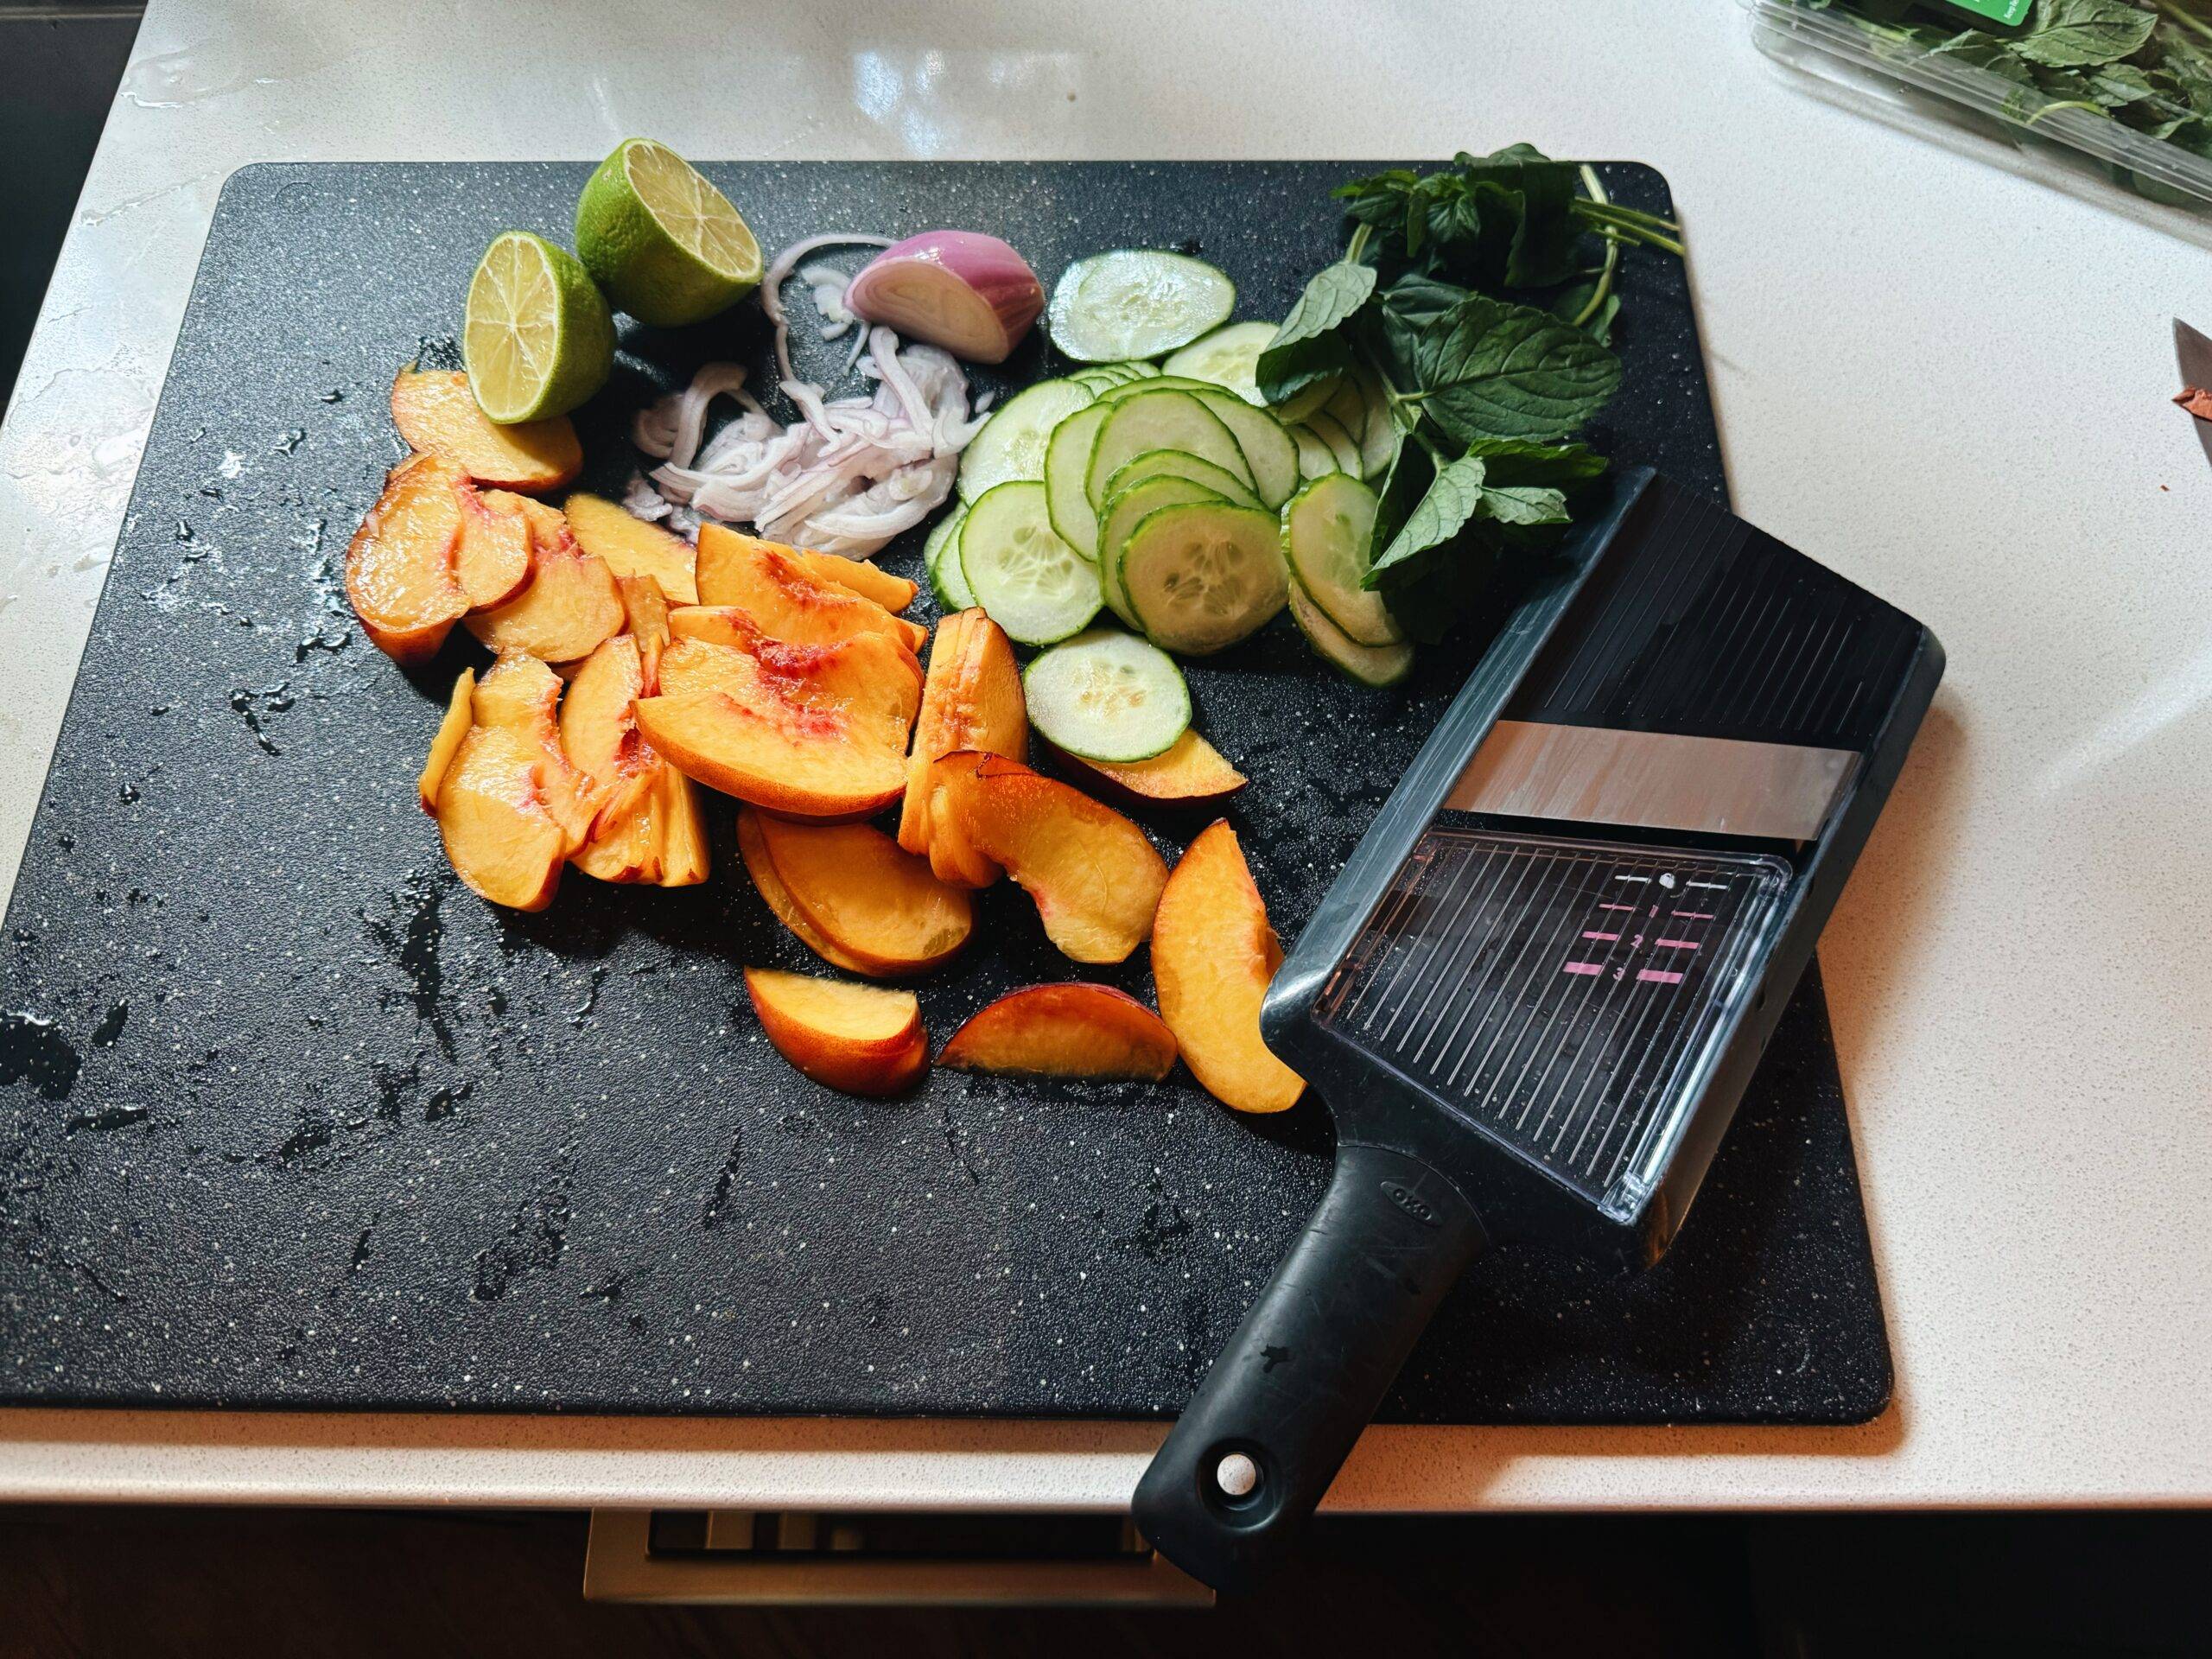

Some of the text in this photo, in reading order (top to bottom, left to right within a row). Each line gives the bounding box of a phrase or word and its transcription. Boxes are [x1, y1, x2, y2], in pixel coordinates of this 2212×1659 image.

[1649, 904, 1659, 918] 1
[1630, 934, 1643, 949] 2
[1612, 967, 1625, 981] 3
[1393, 1188, 1433, 1221] OXO
